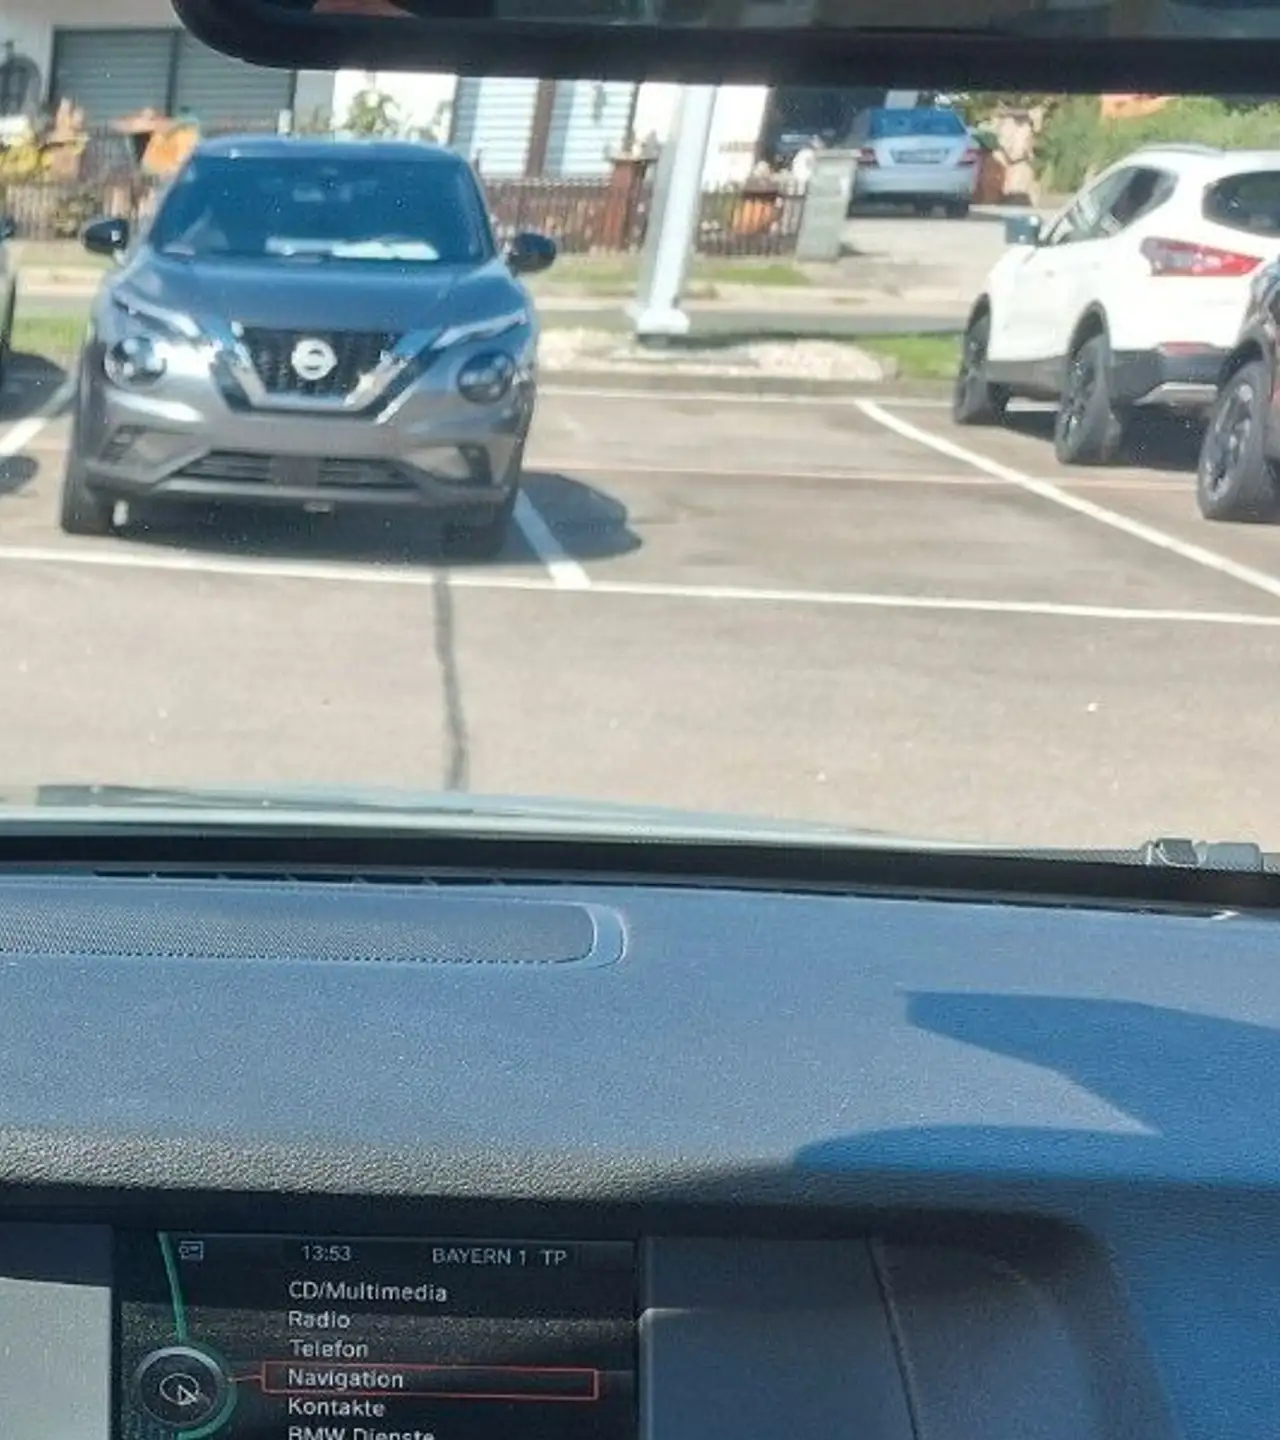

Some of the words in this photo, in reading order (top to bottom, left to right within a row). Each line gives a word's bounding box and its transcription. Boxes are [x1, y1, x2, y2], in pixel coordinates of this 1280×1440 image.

[302, 1245, 352, 1262] 13:53
[432, 1248, 511, 1265] BAYERN
[519, 1250, 527, 1266] 1
[542, 1250, 569, 1266] TP
[288, 1281, 447, 1303] CD/Multimedia
[288, 1310, 351, 1330] Radio
[289, 1339, 369, 1359] Telefon
[288, 1368, 405, 1391] Navigation
[288, 1397, 386, 1417] Kontakte
